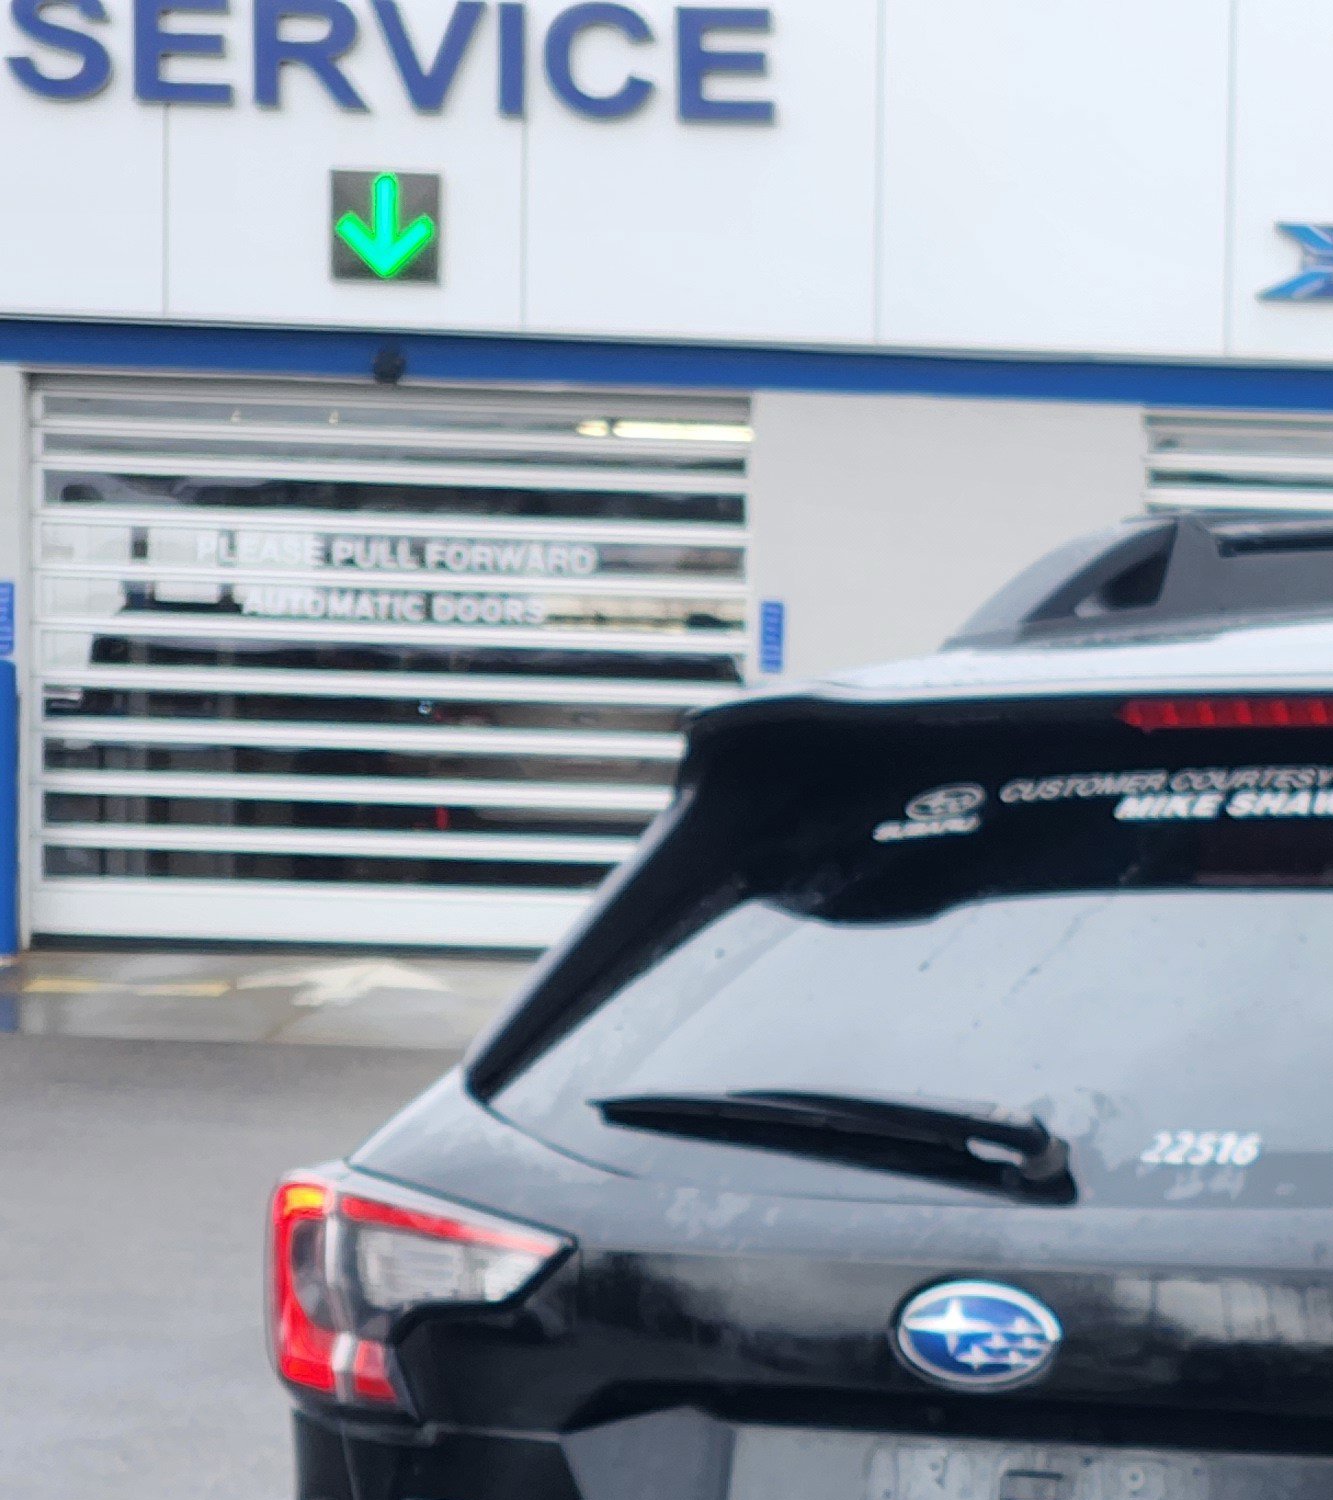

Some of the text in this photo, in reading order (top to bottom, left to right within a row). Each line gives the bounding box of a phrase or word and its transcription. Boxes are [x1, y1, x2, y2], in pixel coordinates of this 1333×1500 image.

[4, 0, 776, 126] SERVICE
[196, 534, 599, 575] PLEASE PULL FORWARD
[242, 586, 547, 625] AUTOMATIC DOORS
[1000, 771, 1168, 803] CUSTOMER
[1113, 793, 1225, 820] MIKE
